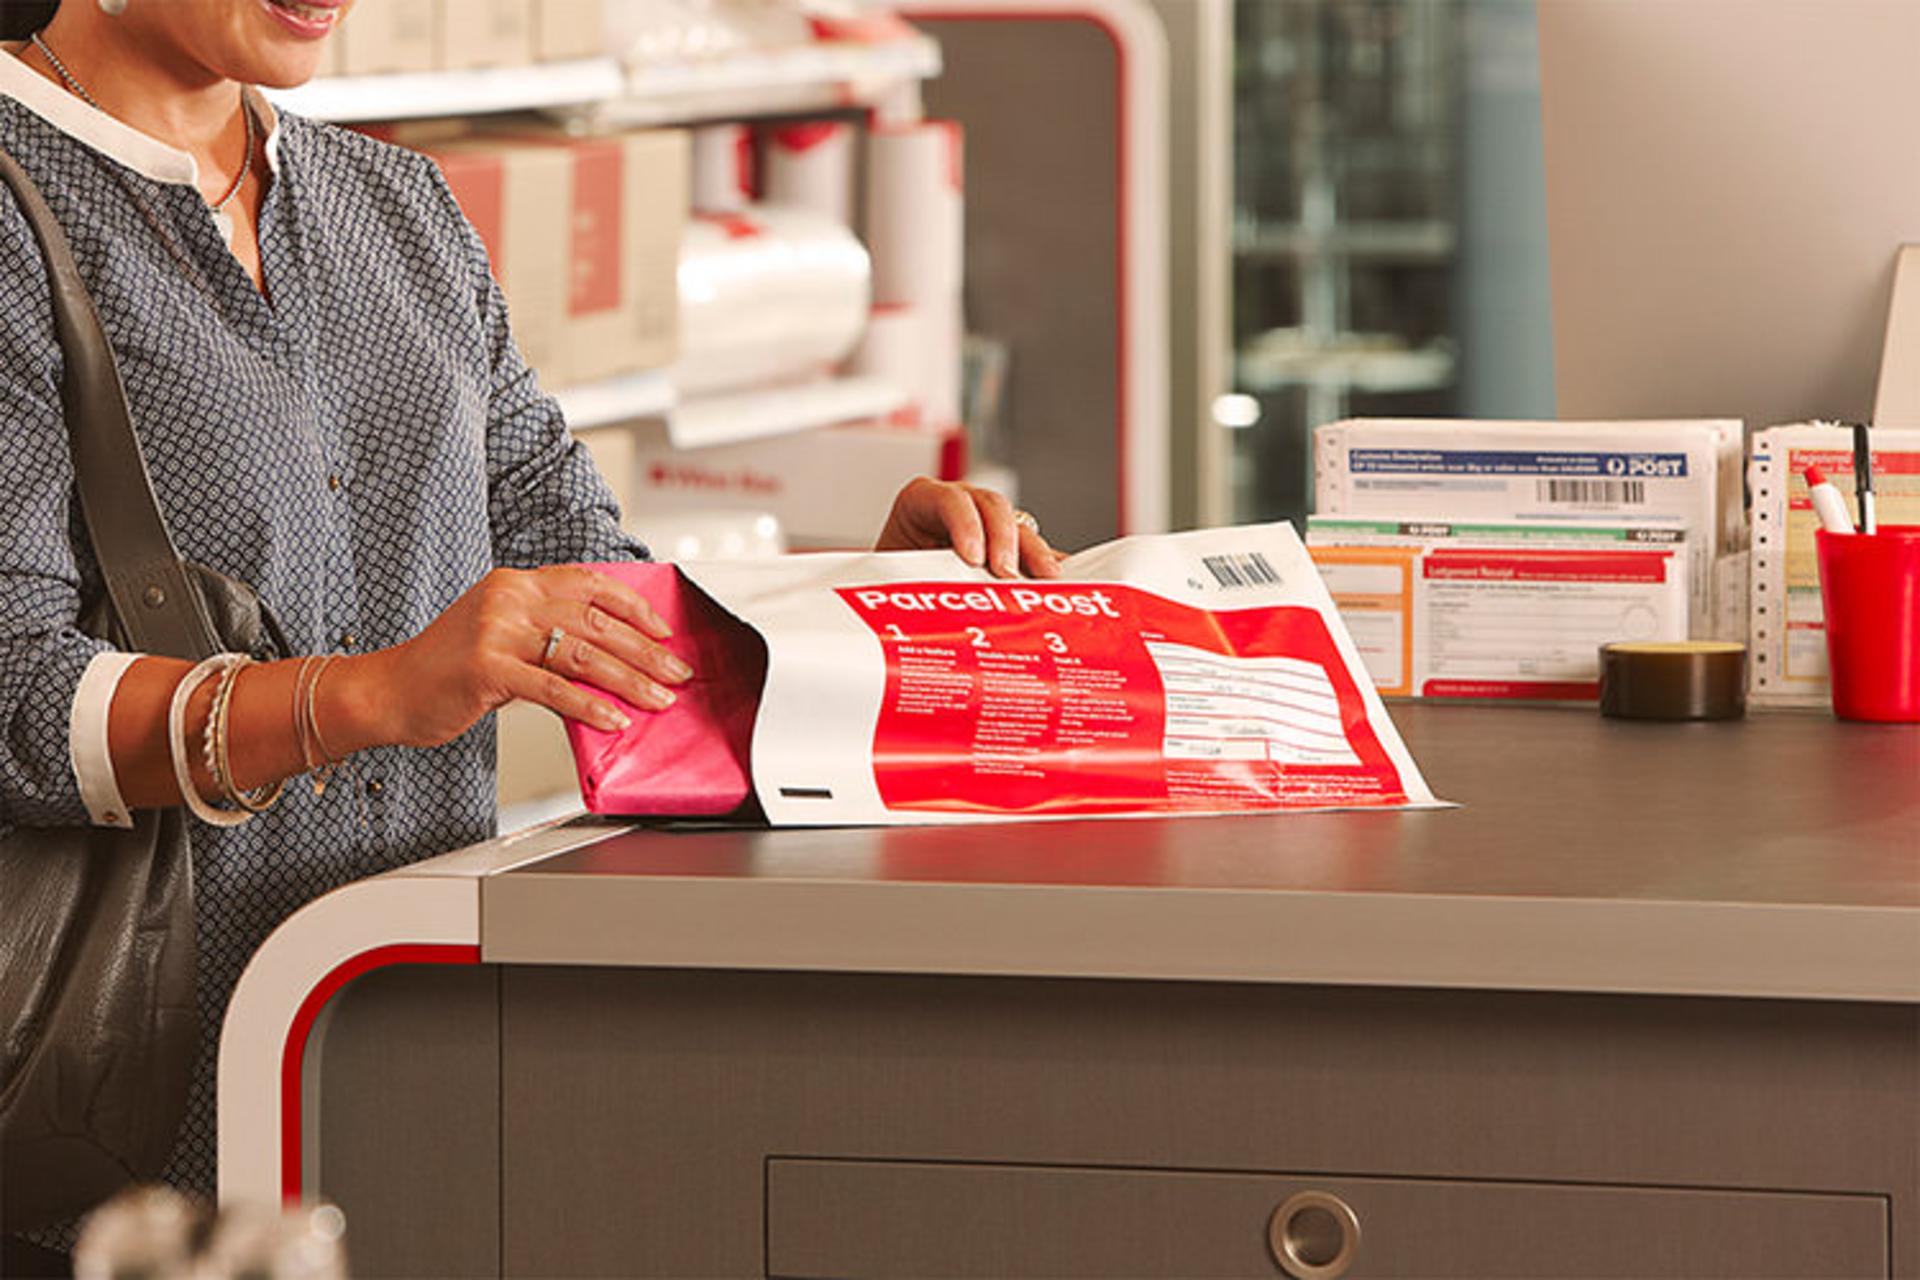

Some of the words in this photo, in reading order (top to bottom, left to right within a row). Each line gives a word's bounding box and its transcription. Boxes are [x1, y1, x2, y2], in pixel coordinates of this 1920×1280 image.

[1628, 459, 1682, 475] POST
[855, 587, 1007, 612] Parcel
[1010, 587, 1121, 619] Post
[885, 624, 912, 642] 1
[965, 626, 992, 648] 2
[1043, 632, 1069, 654] 3
